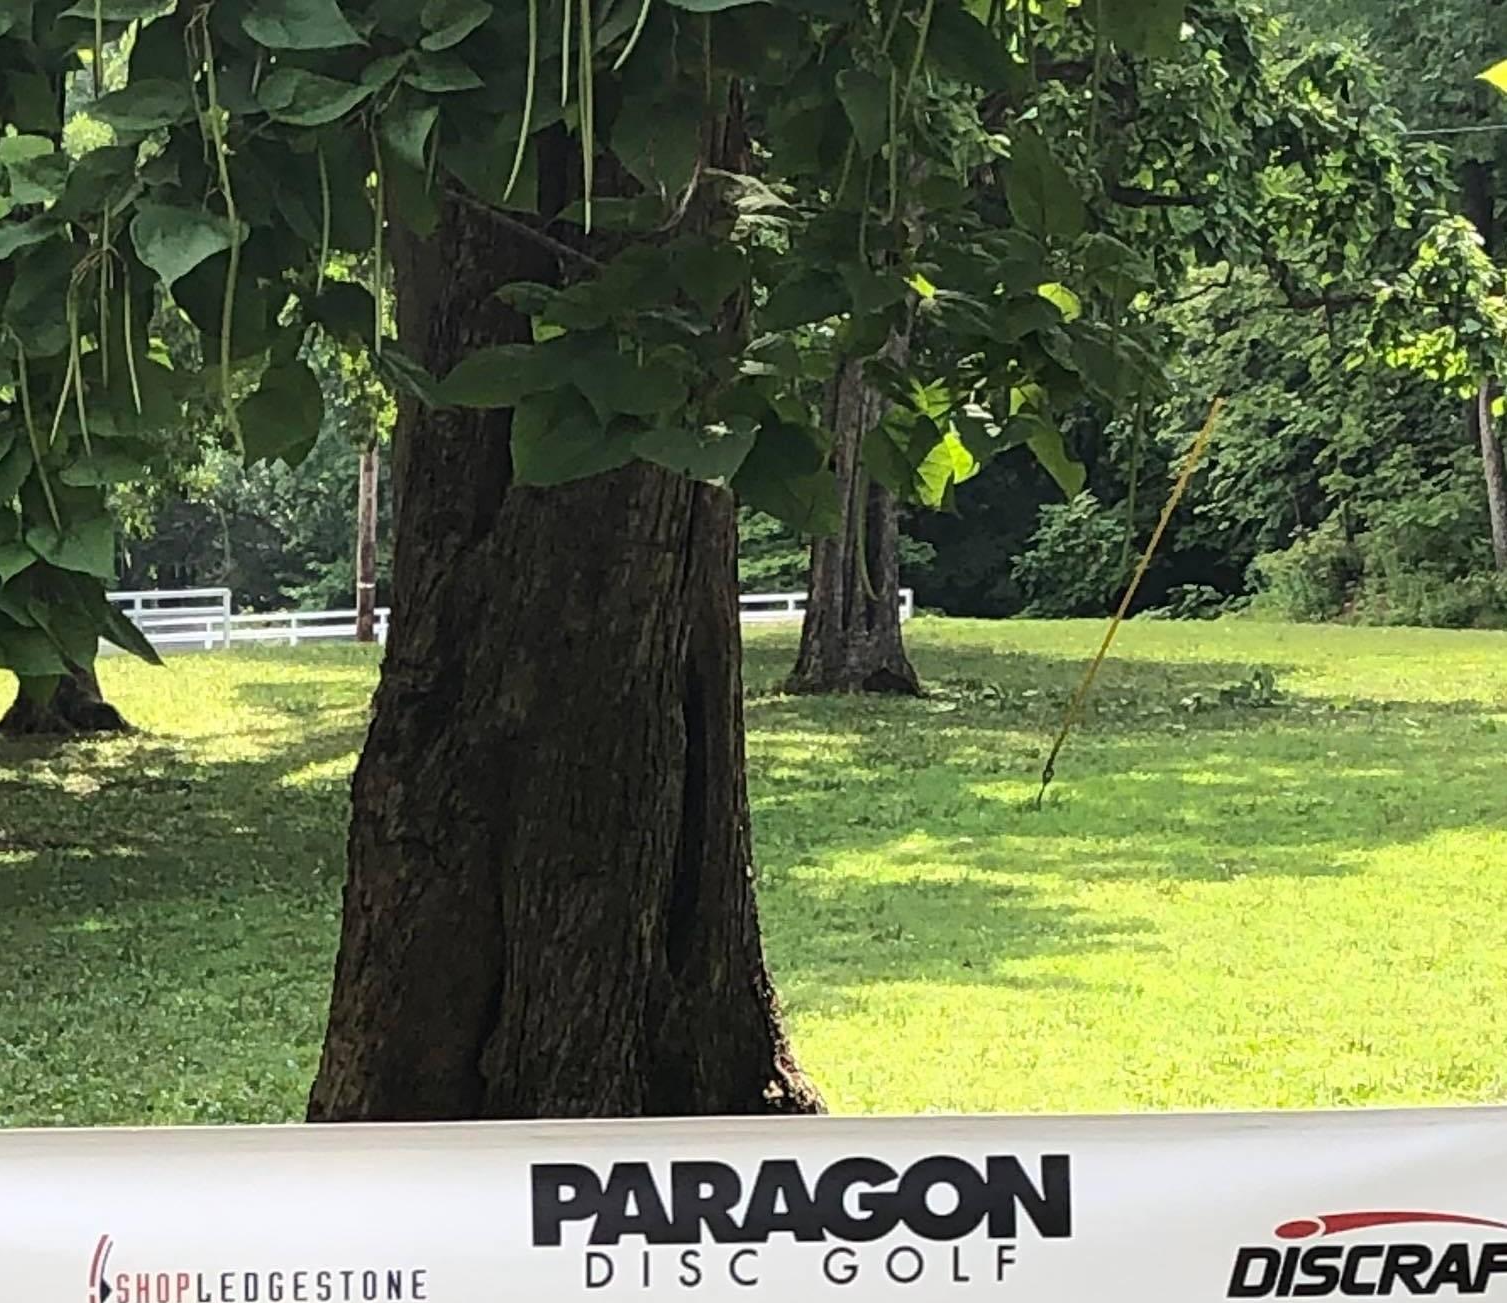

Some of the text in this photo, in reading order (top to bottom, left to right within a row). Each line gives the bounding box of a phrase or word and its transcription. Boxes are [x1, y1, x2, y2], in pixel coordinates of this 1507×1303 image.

[530, 1154, 1071, 1247] PARAGON
[585, 1245, 1016, 1289] DISC GOLF
